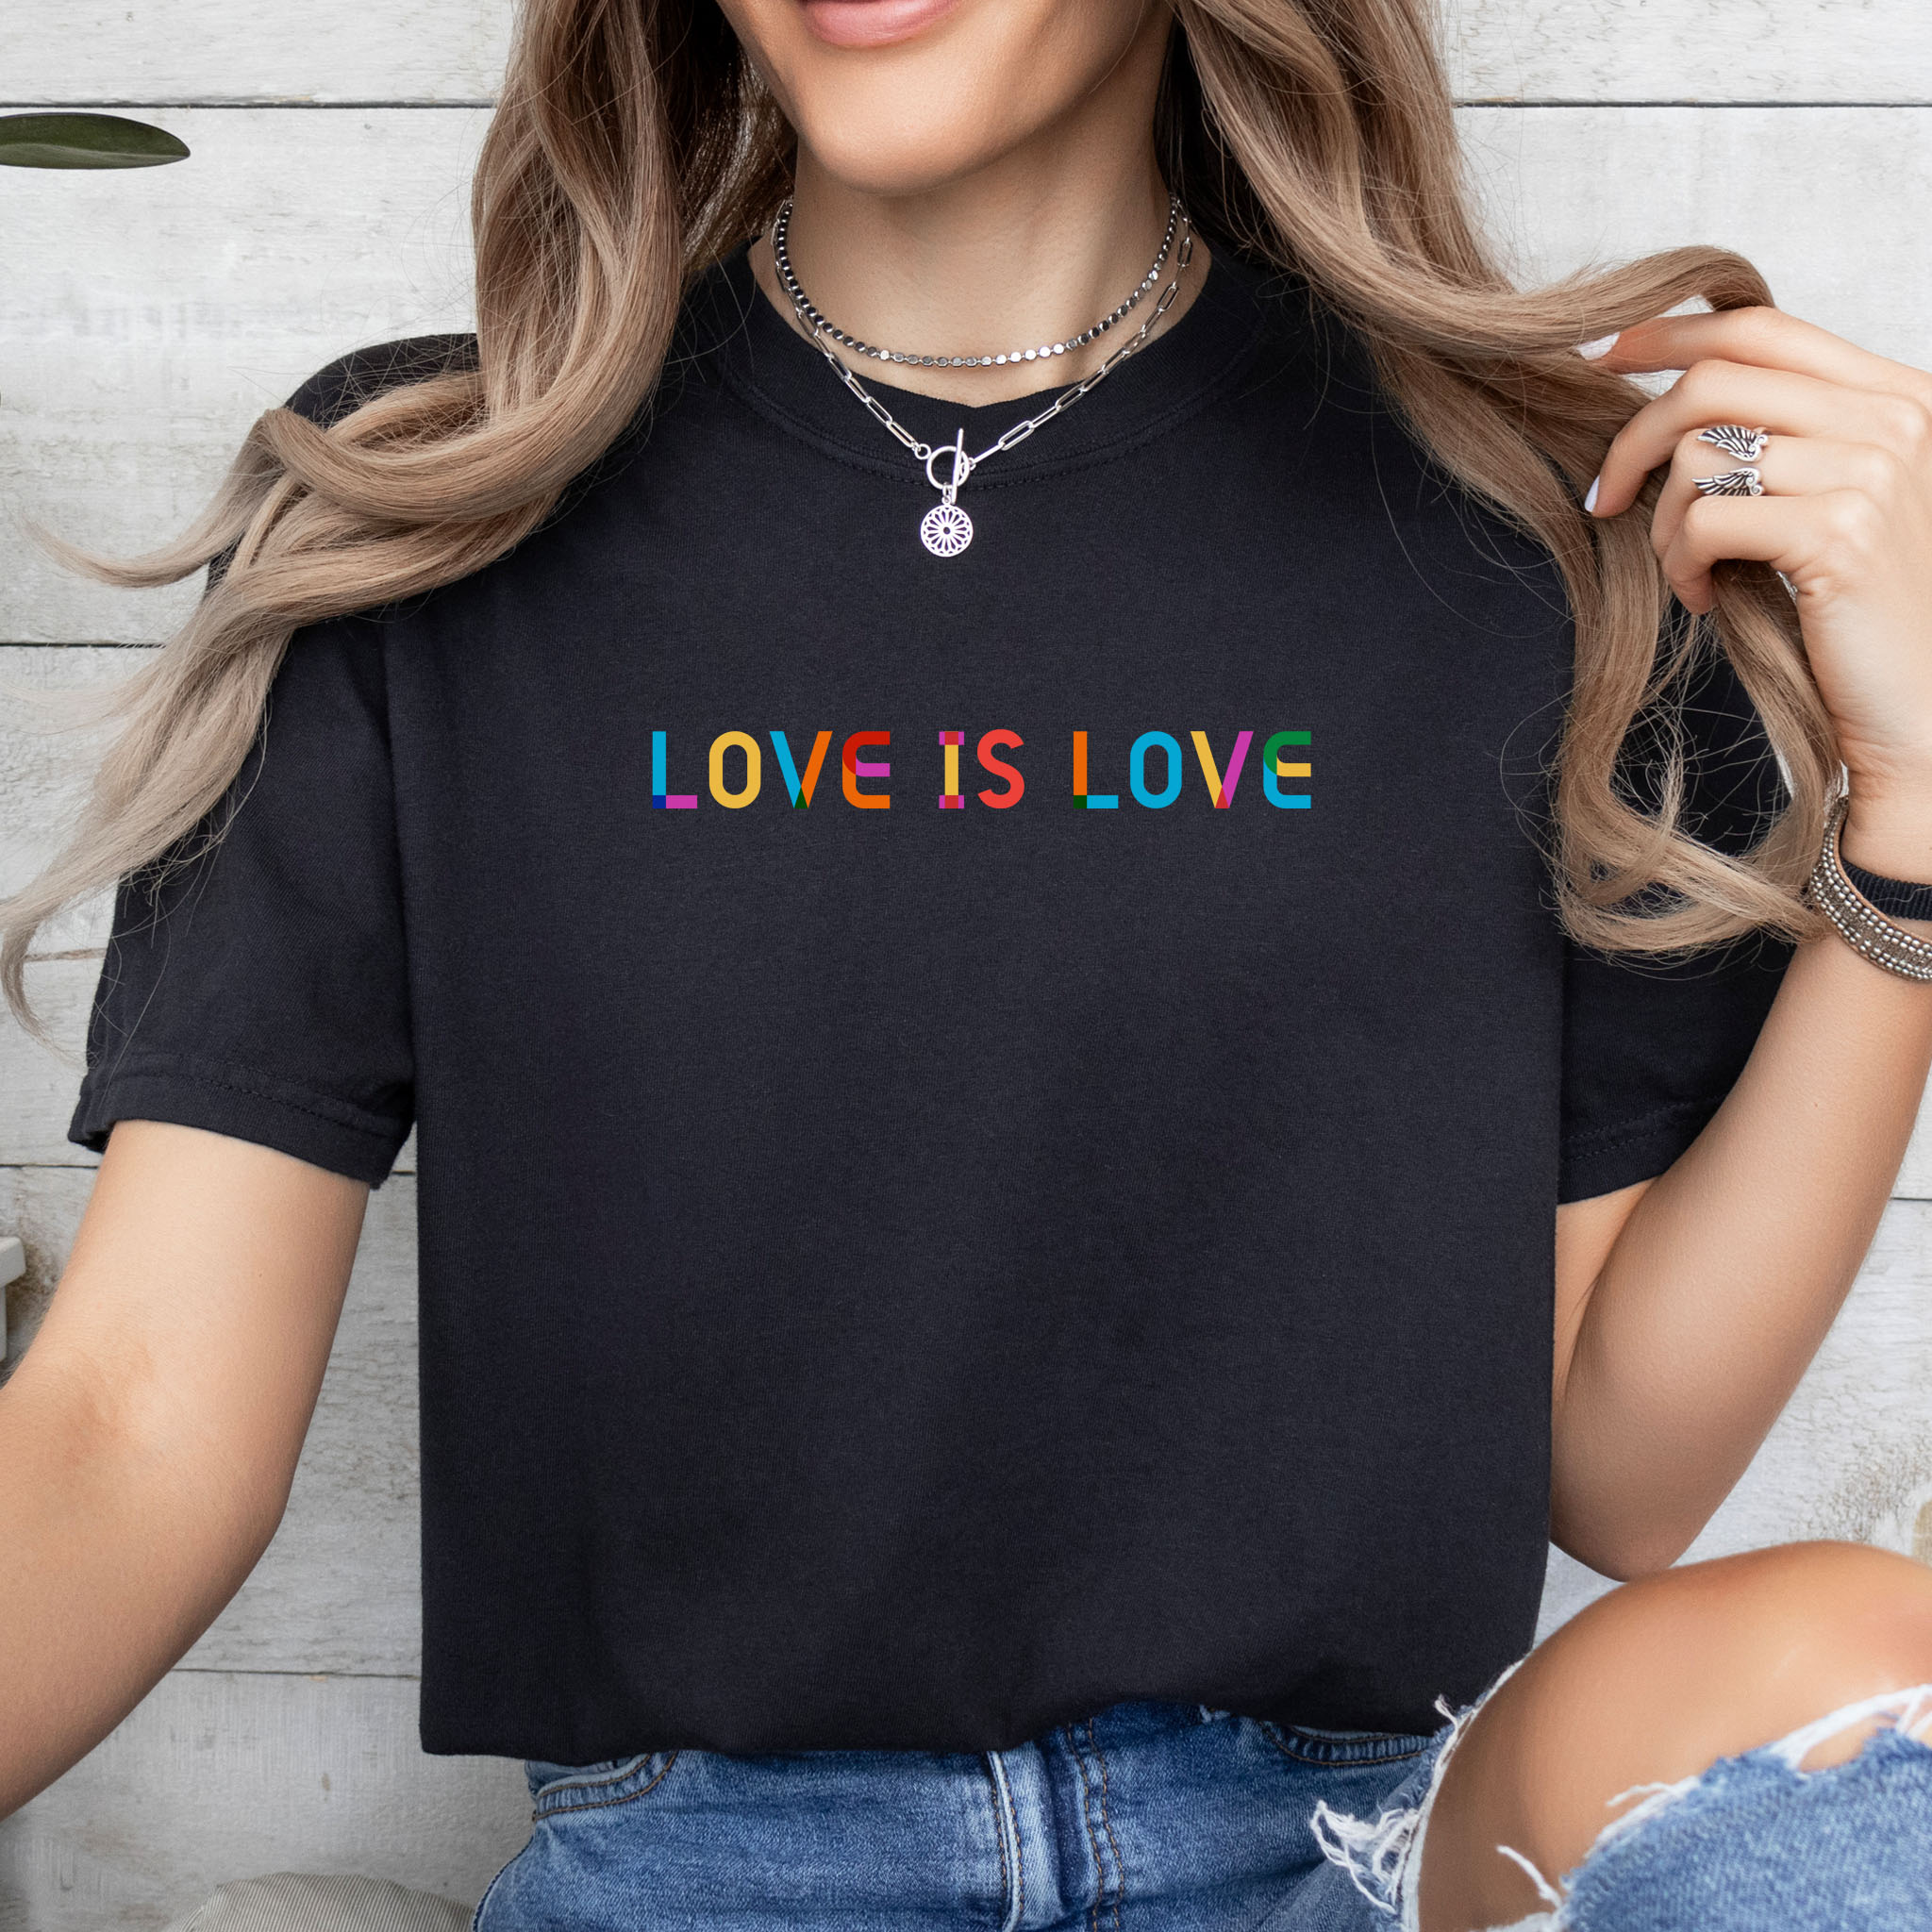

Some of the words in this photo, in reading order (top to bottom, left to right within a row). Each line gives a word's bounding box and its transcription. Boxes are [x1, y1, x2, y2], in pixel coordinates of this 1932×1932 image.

[652, 731, 891, 808] LOVE
[939, 729, 1024, 808] IS
[1073, 731, 1311, 808] LOVE
